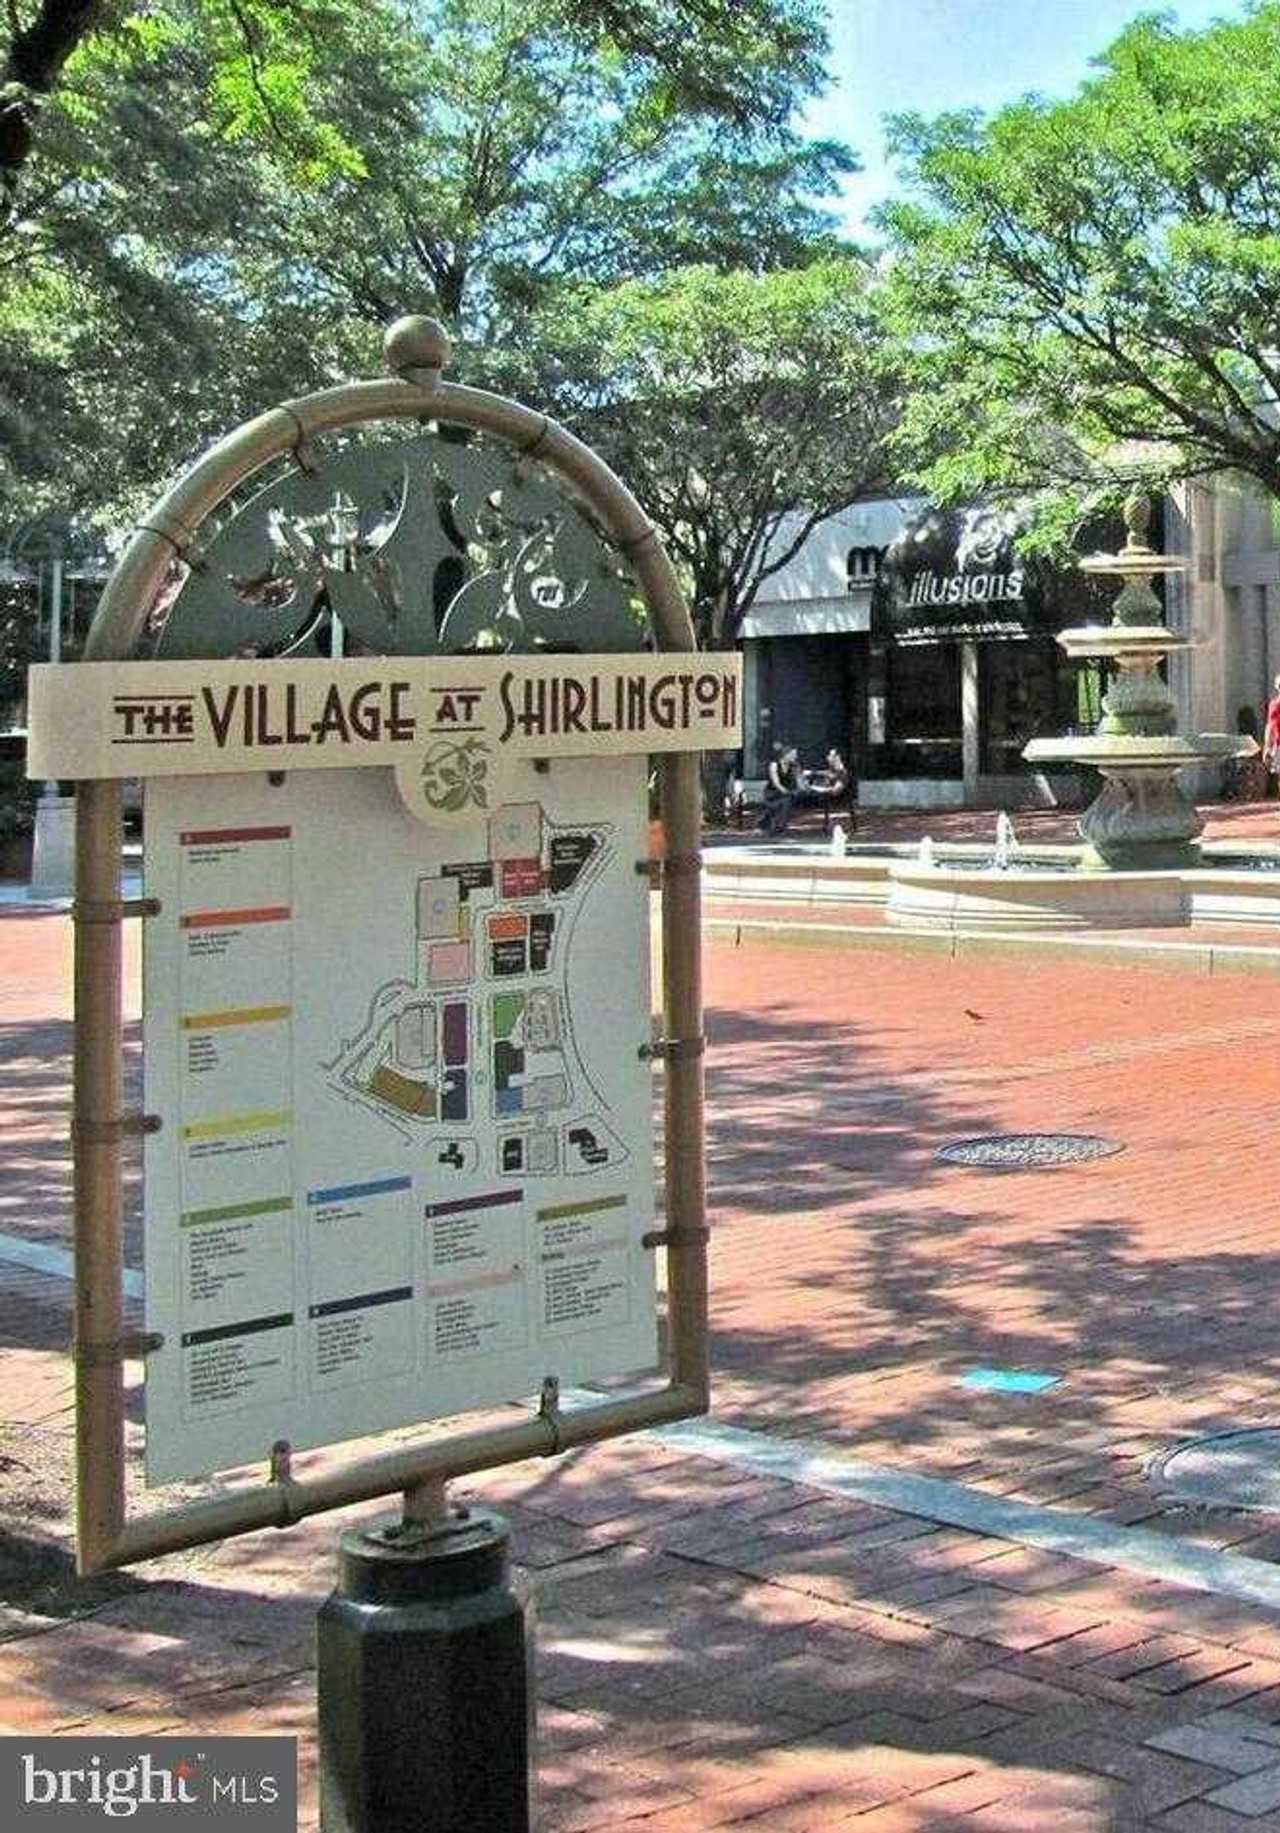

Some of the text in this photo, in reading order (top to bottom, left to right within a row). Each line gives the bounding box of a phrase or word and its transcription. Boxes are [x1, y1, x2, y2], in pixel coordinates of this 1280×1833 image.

[909, 570, 1024, 605] illusions
[112, 671, 737, 748] THE VILLAGE AT SHIRLINGTON
